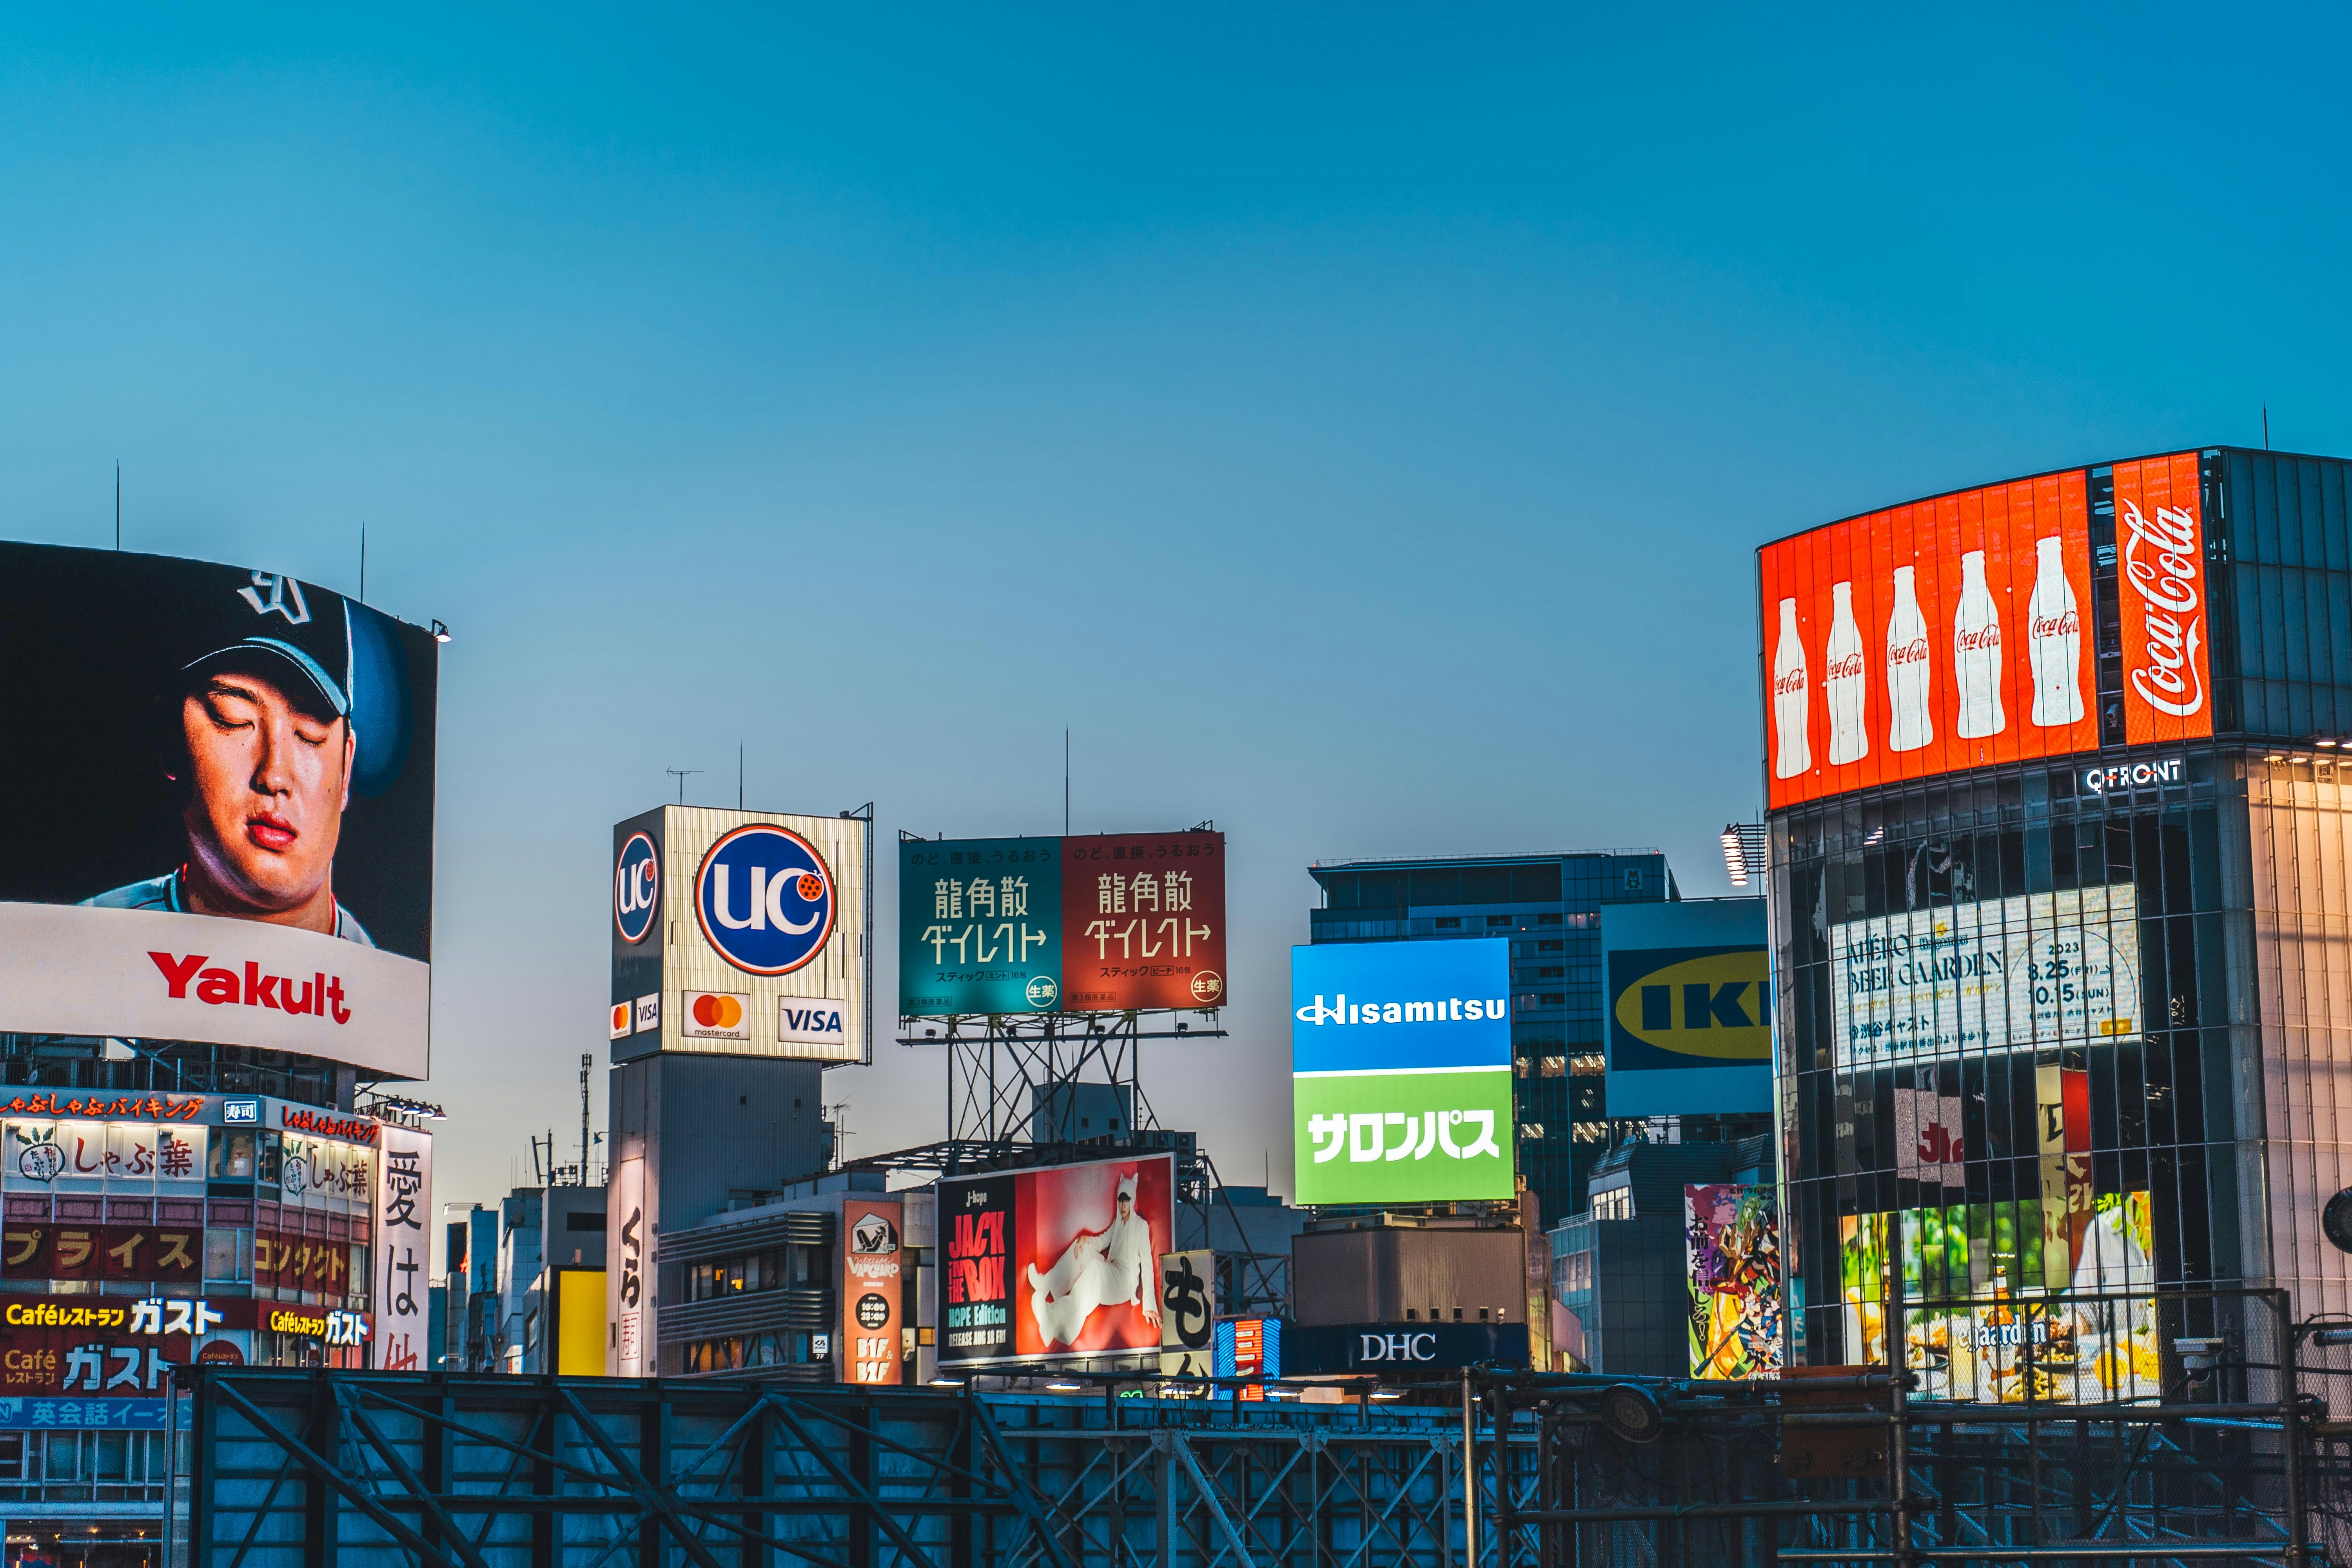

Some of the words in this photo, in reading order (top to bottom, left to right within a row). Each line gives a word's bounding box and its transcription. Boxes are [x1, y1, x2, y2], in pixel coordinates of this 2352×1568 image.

[2122, 498, 2203, 717] Coca-Cola
[1888, 638, 1927, 667] Coca-Cola
[1957, 624, 2000, 653] Coca-Cola
[2086, 760, 2181, 794] QFRONT
[911, 849, 1050, 866] のど、直接、うるおう
[1074, 843, 1215, 860] のど、直接、うるおう
[935, 876, 1029, 919] 龍角散
[1098, 870, 1193, 914] 龍角散
[921, 923, 1047, 965] ダイレクト
[1085, 918, 1212, 960] ダイレクト
[2049, 942, 2080, 955] 2023
[936, 971, 984, 982] スティック
[1100, 966, 1149, 977] スティック
[147, 951, 351, 1024] Yakult
[1029, 985, 1055, 998] 生薬
[1072, 993, 1114, 1001] 第3類医薬品
[1193, 980, 1219, 993] 生薬
[638, 1003, 657, 1022] VISA
[781, 1009, 842, 1032] VISA
[1296, 994, 1505, 1025] Hisamitsu
[695, 1028, 740, 1038] mastercard
[227, 1103, 254, 1120] 寿司
[283, 1105, 379, 1143] しゃぶしゃぶバイキング
[1308, 1109, 1499, 1163] サロンパス
[75, 1137, 192, 1178] しゃぶ葉
[312, 1153, 367, 1196] しゃぶ葉
[966, 1190, 987, 1207] j-hope
[5, 1229, 193, 1269] プライス
[949, 1211, 1005, 1259] JACK
[255, 1239, 345, 1281] コンタクト
[621, 1206, 641, 1308] くら
[964, 1256, 1005, 1302] BOX
[130, 1297, 224, 1335] ガスト
[325, 1310, 369, 1346] ガスト
[949, 1306, 971, 1328] HOPE
[974, 1303, 1006, 1327] Edition
[857, 1338, 889, 1358] B1F
[949, 1332, 973, 1347] RELEASE
[996, 1329, 1006, 1344] FRI
[1361, 1334, 1436, 1361] DHC
[5, 1349, 56, 1370] Café
[64, 1344, 179, 1390] ガスト
[857, 1361, 890, 1382] B2F
[6, 1372, 55, 1385] レストラン
